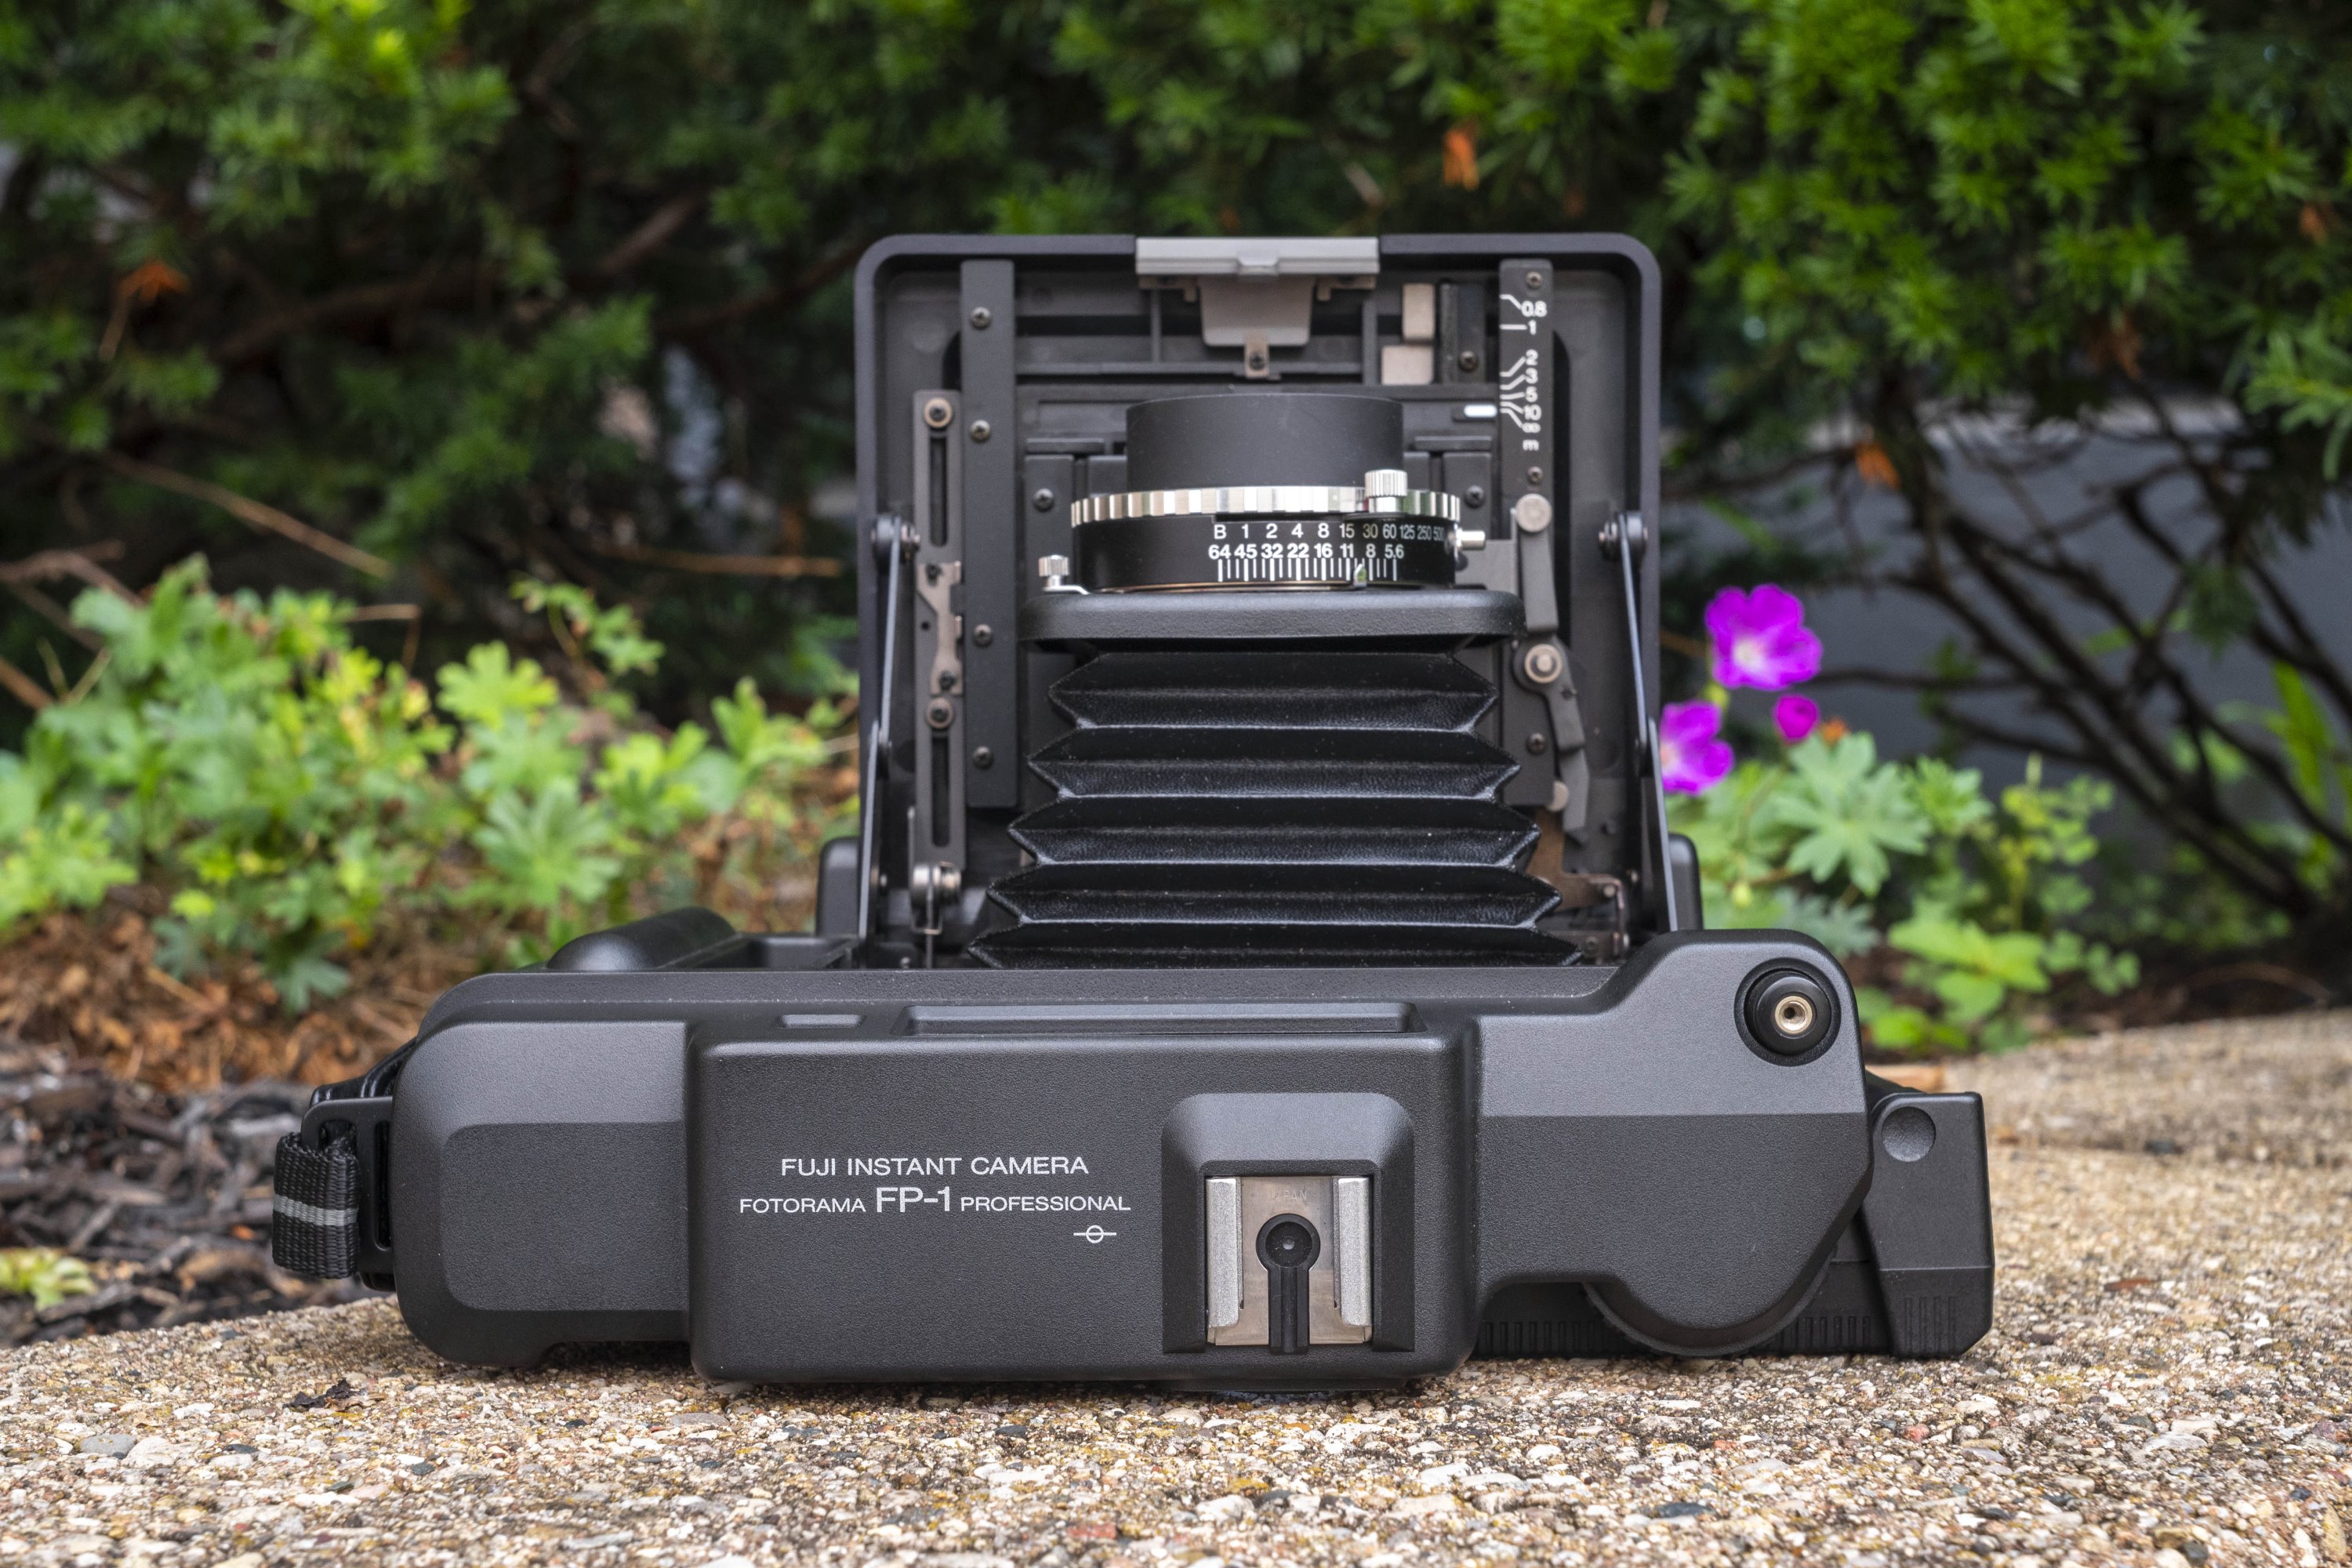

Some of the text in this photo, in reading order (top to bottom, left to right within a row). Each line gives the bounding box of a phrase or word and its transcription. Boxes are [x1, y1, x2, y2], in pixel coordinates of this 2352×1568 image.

[1528, 319, 1537, 335] 1
[1526, 349, 1538, 366] 2
[1526, 367, 1538, 384] 3
[1526, 386, 1538, 402] 5
[1523, 404, 1542, 421] 10
[1522, 439, 1540, 452] m
[1213, 523, 1227, 539] B
[1241, 523, 1249, 539] 1
[1265, 523, 1278, 539] 2
[1291, 523, 1304, 539] 4
[1317, 523, 1330, 539] 8
[1339, 523, 1355, 539] 15
[1363, 523, 1379, 539] 30
[1382, 524, 1397, 539] 60
[1400, 524, 1415, 539] 125
[1417, 525, 1432, 540] 250
[1208, 543, 1405, 560] 64 45 32 22 16 11 8 5.6
[781, 1156, 1090, 1176] FUJI INSTANT CAMERA
[739, 1185, 1131, 1214] FOTORAMA FP-1 PROFESSIONAL
